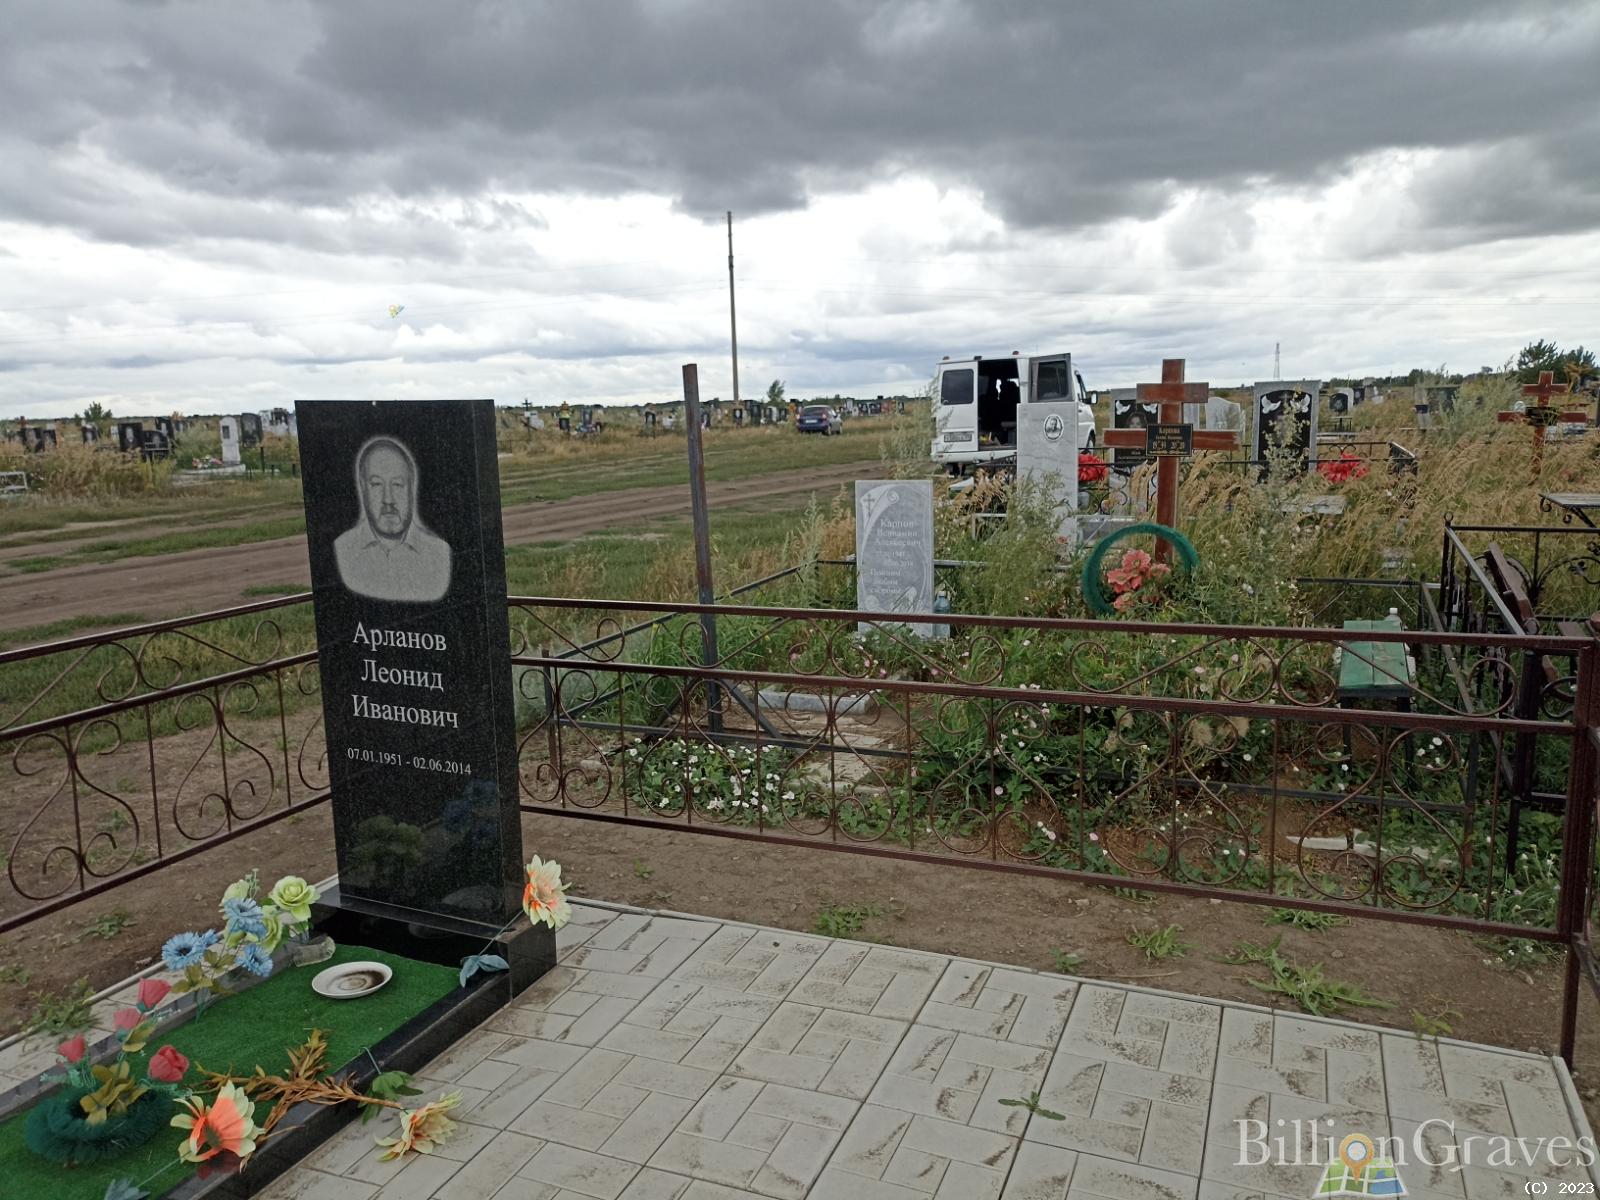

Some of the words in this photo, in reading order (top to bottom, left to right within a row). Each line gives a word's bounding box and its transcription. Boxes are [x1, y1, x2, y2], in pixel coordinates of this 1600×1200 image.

[352, 621, 447, 651] Арланов
[361, 659, 444, 692] Леонид
[351, 694, 459, 729] Иванович
[347, 747, 402, 766] 07.01.1951
[413, 756, 472, 775] 02.06.2014
